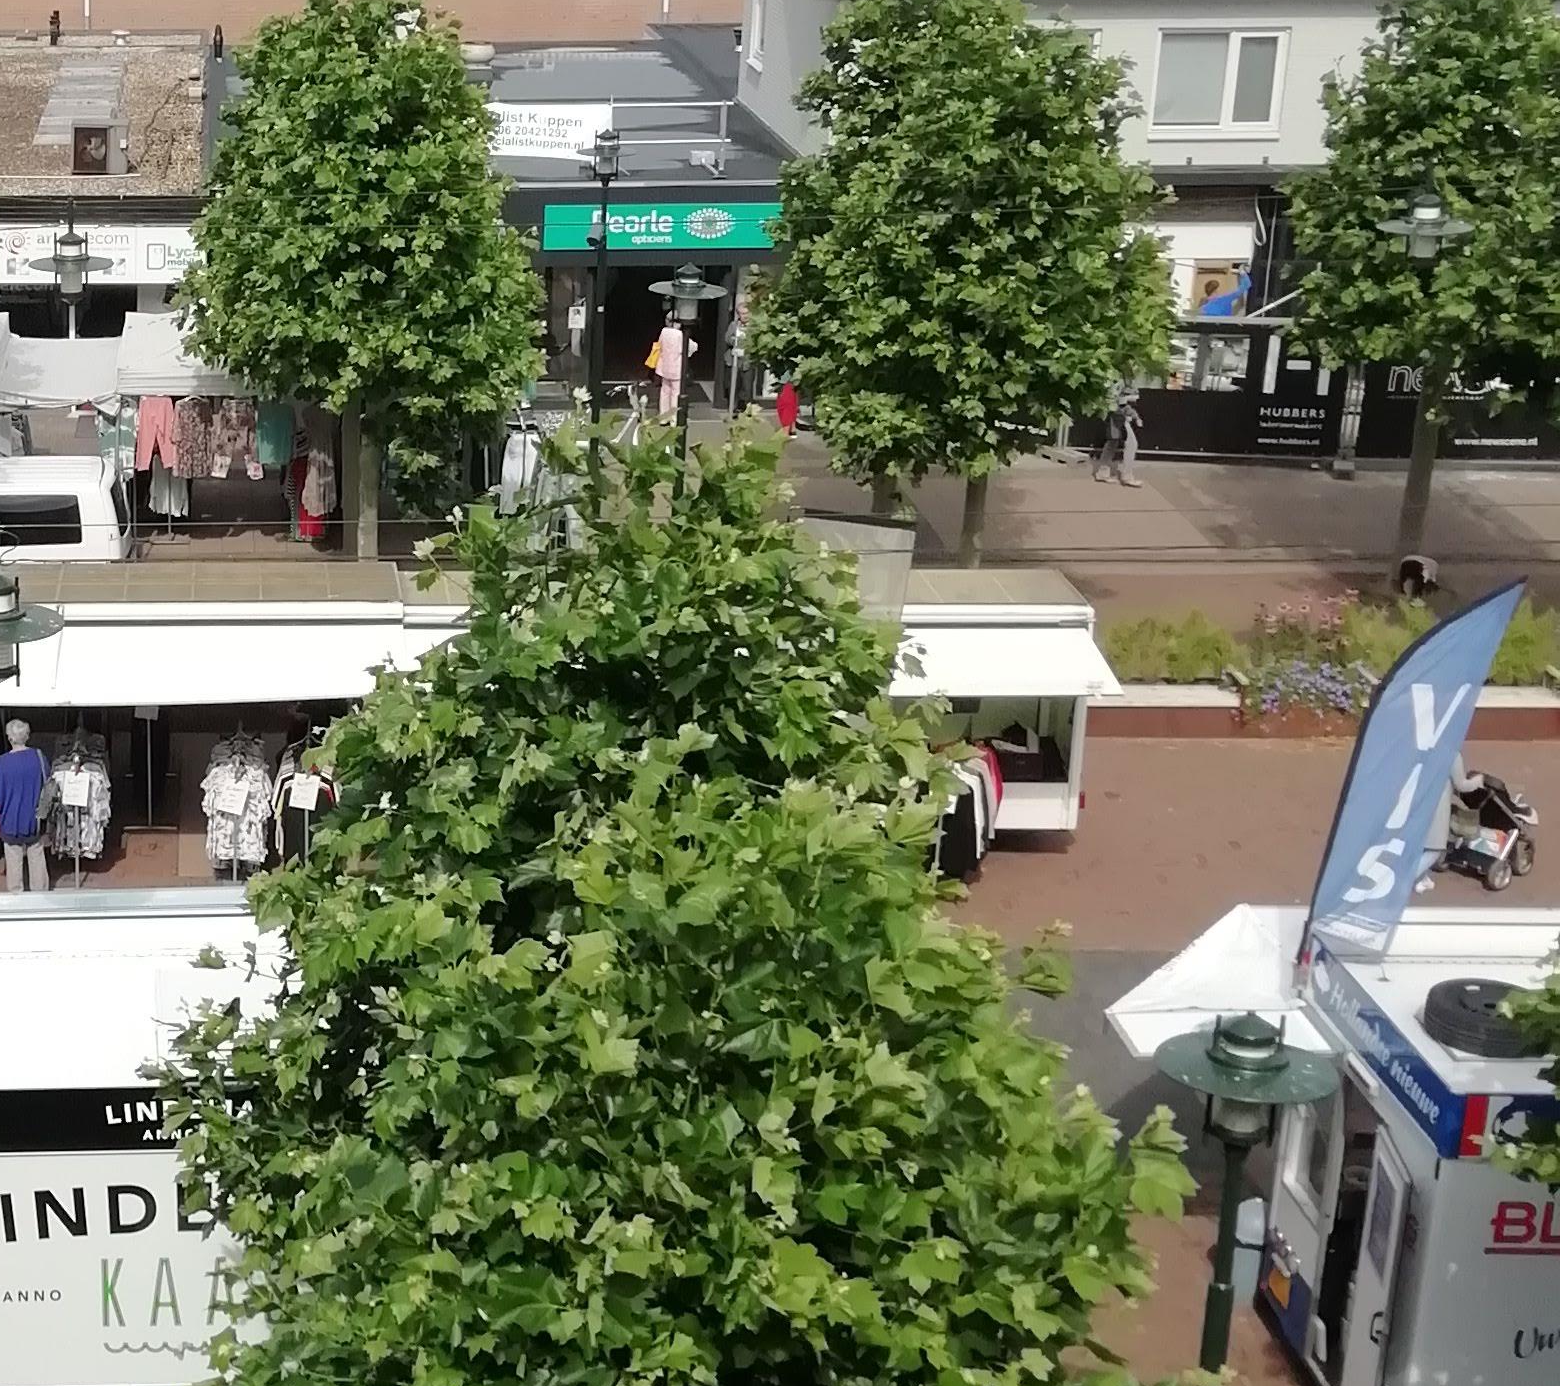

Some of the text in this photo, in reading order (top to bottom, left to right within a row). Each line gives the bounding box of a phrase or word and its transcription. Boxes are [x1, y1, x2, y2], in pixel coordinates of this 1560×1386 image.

[515, 126, 568, 138] 20421292
[167, 245, 201, 259] Lyca
[1259, 407, 1326, 419] HUBBERS
[1343, 682, 1472, 902] VIS
[2, 1289, 62, 1302] ANNO
[100, 1257, 250, 1327] KAA
